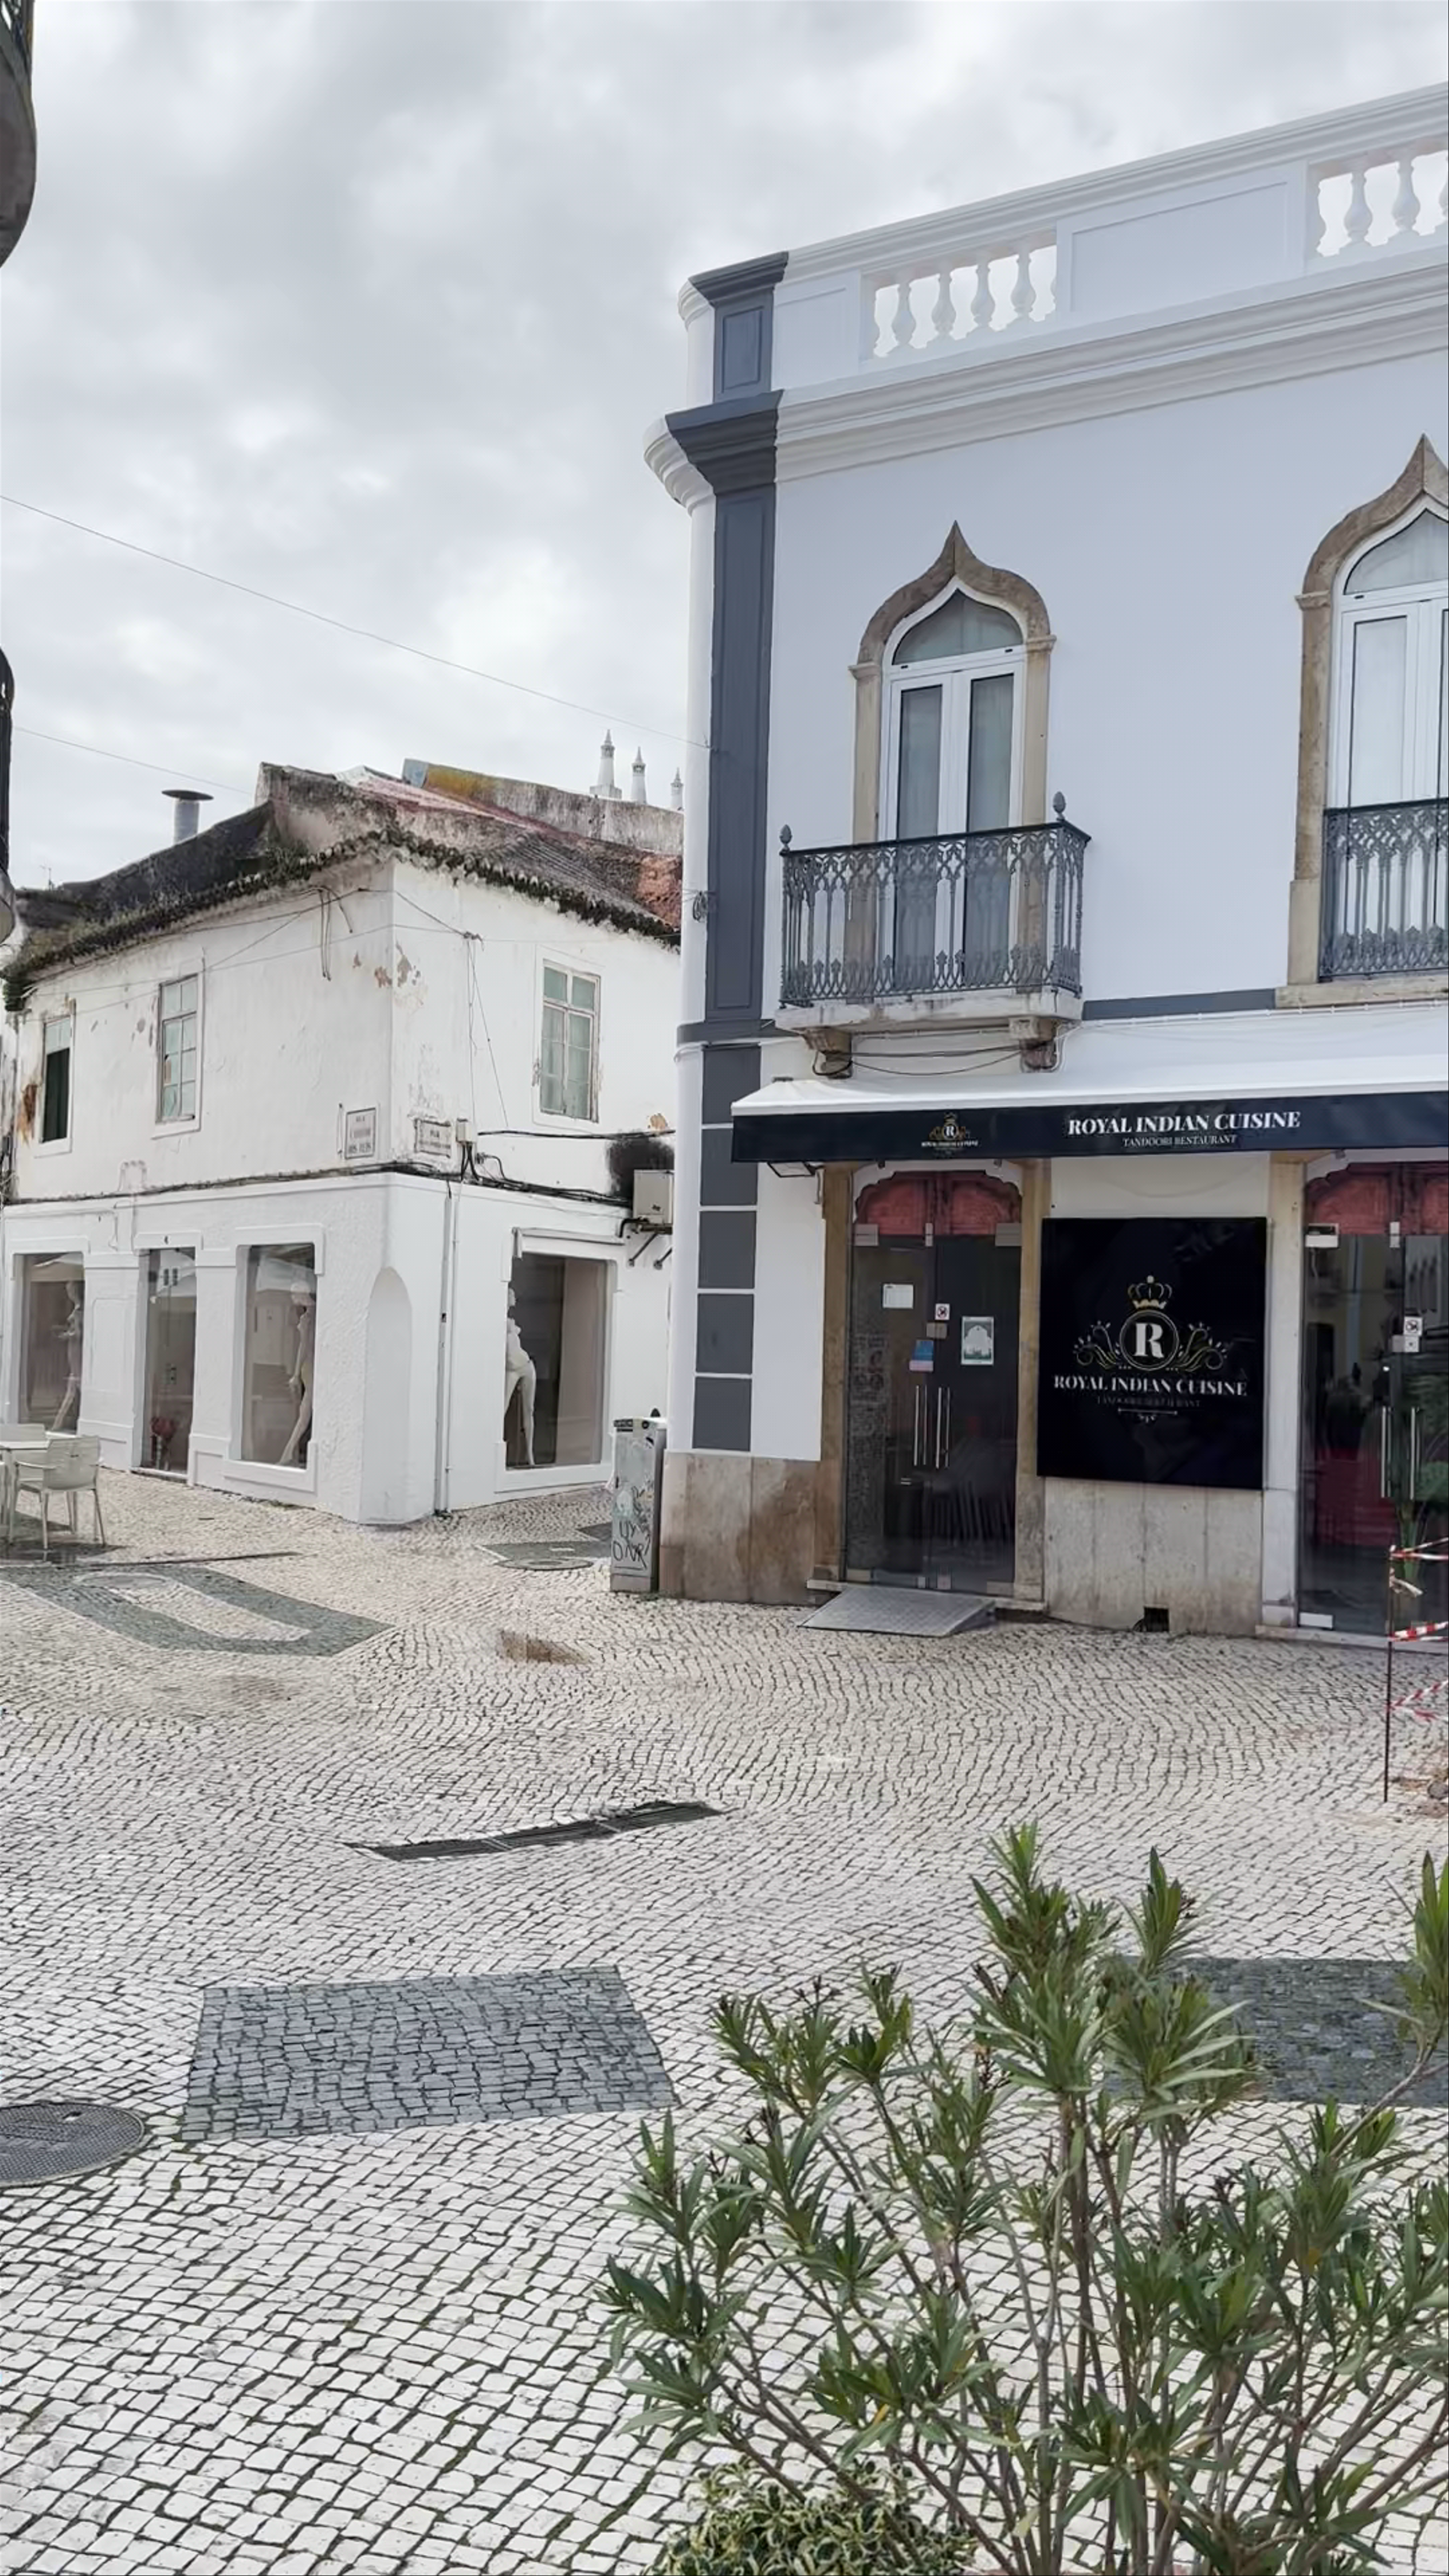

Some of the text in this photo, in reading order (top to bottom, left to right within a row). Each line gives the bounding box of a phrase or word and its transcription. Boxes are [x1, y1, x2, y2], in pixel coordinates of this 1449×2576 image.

[1068, 1112, 1301, 1135] ROYAL INDIAN CUISINE
[1123, 1134, 1237, 1147] TANDOORI RESTAURANT
[1132, 1322, 1164, 1358] R
[1054, 1375, 1247, 1396] ROYAL INDIAN CUISINE
